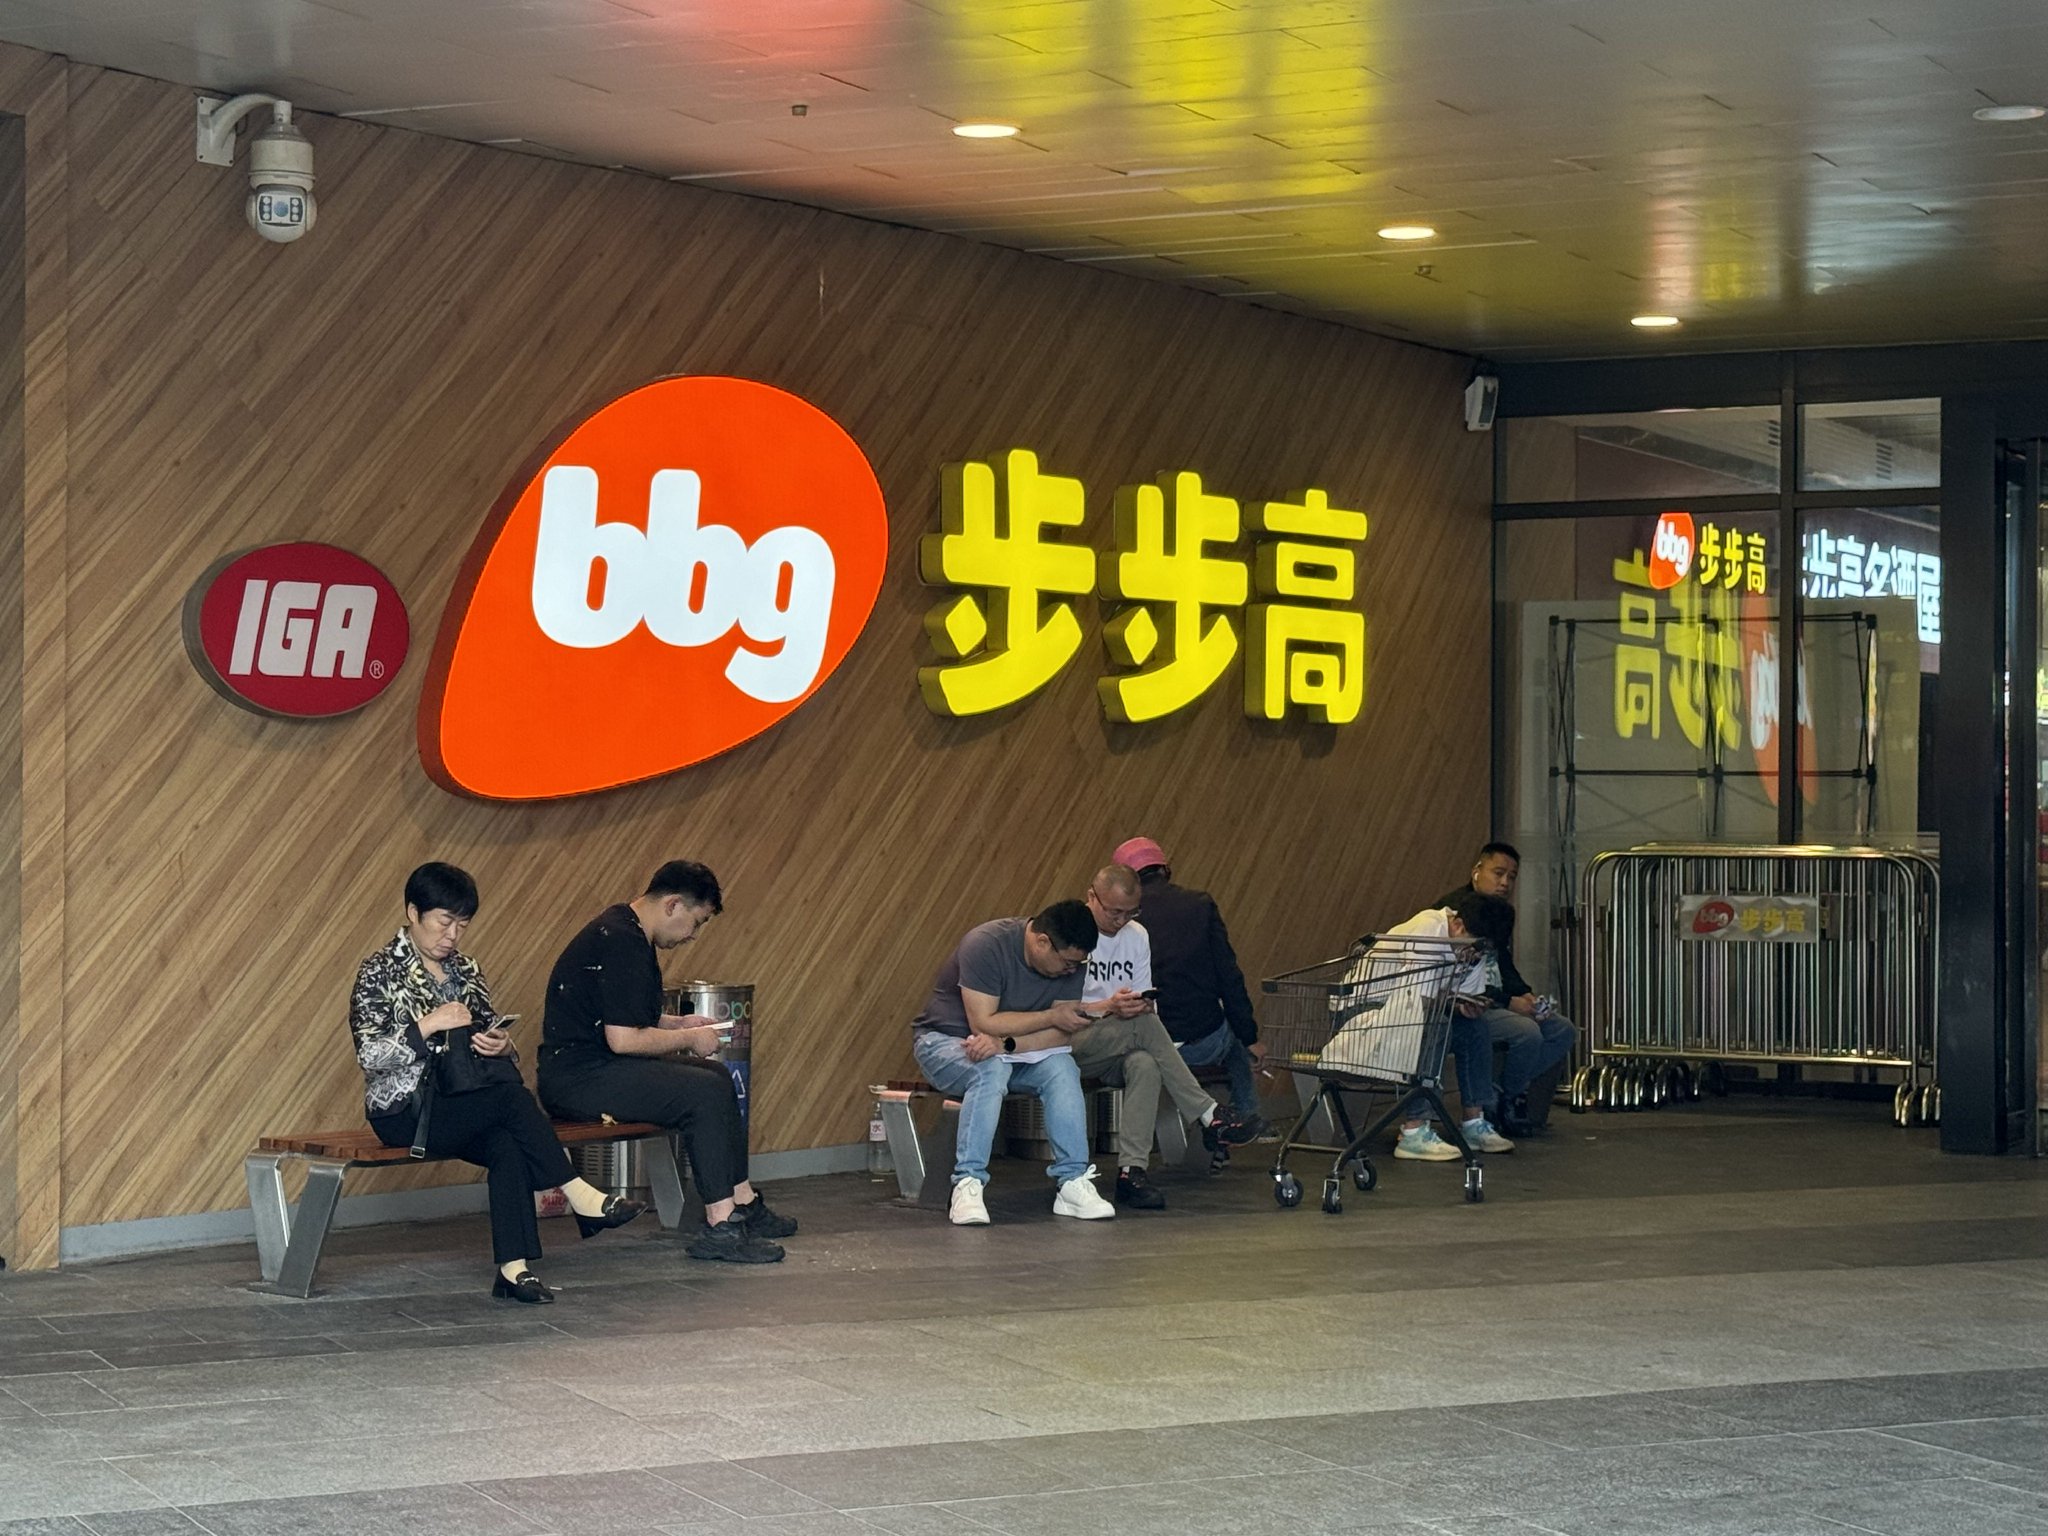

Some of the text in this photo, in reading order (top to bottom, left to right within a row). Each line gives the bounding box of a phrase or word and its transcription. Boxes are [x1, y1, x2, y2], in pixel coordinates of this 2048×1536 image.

[532, 448, 1368, 724] bbg 步步高
[1656, 518, 1767, 595] bbg 步步高
[228, 579, 378, 679] IGA
[1740, 907, 1806, 933] 步步高
[1088, 960, 1134, 982] ASICS
